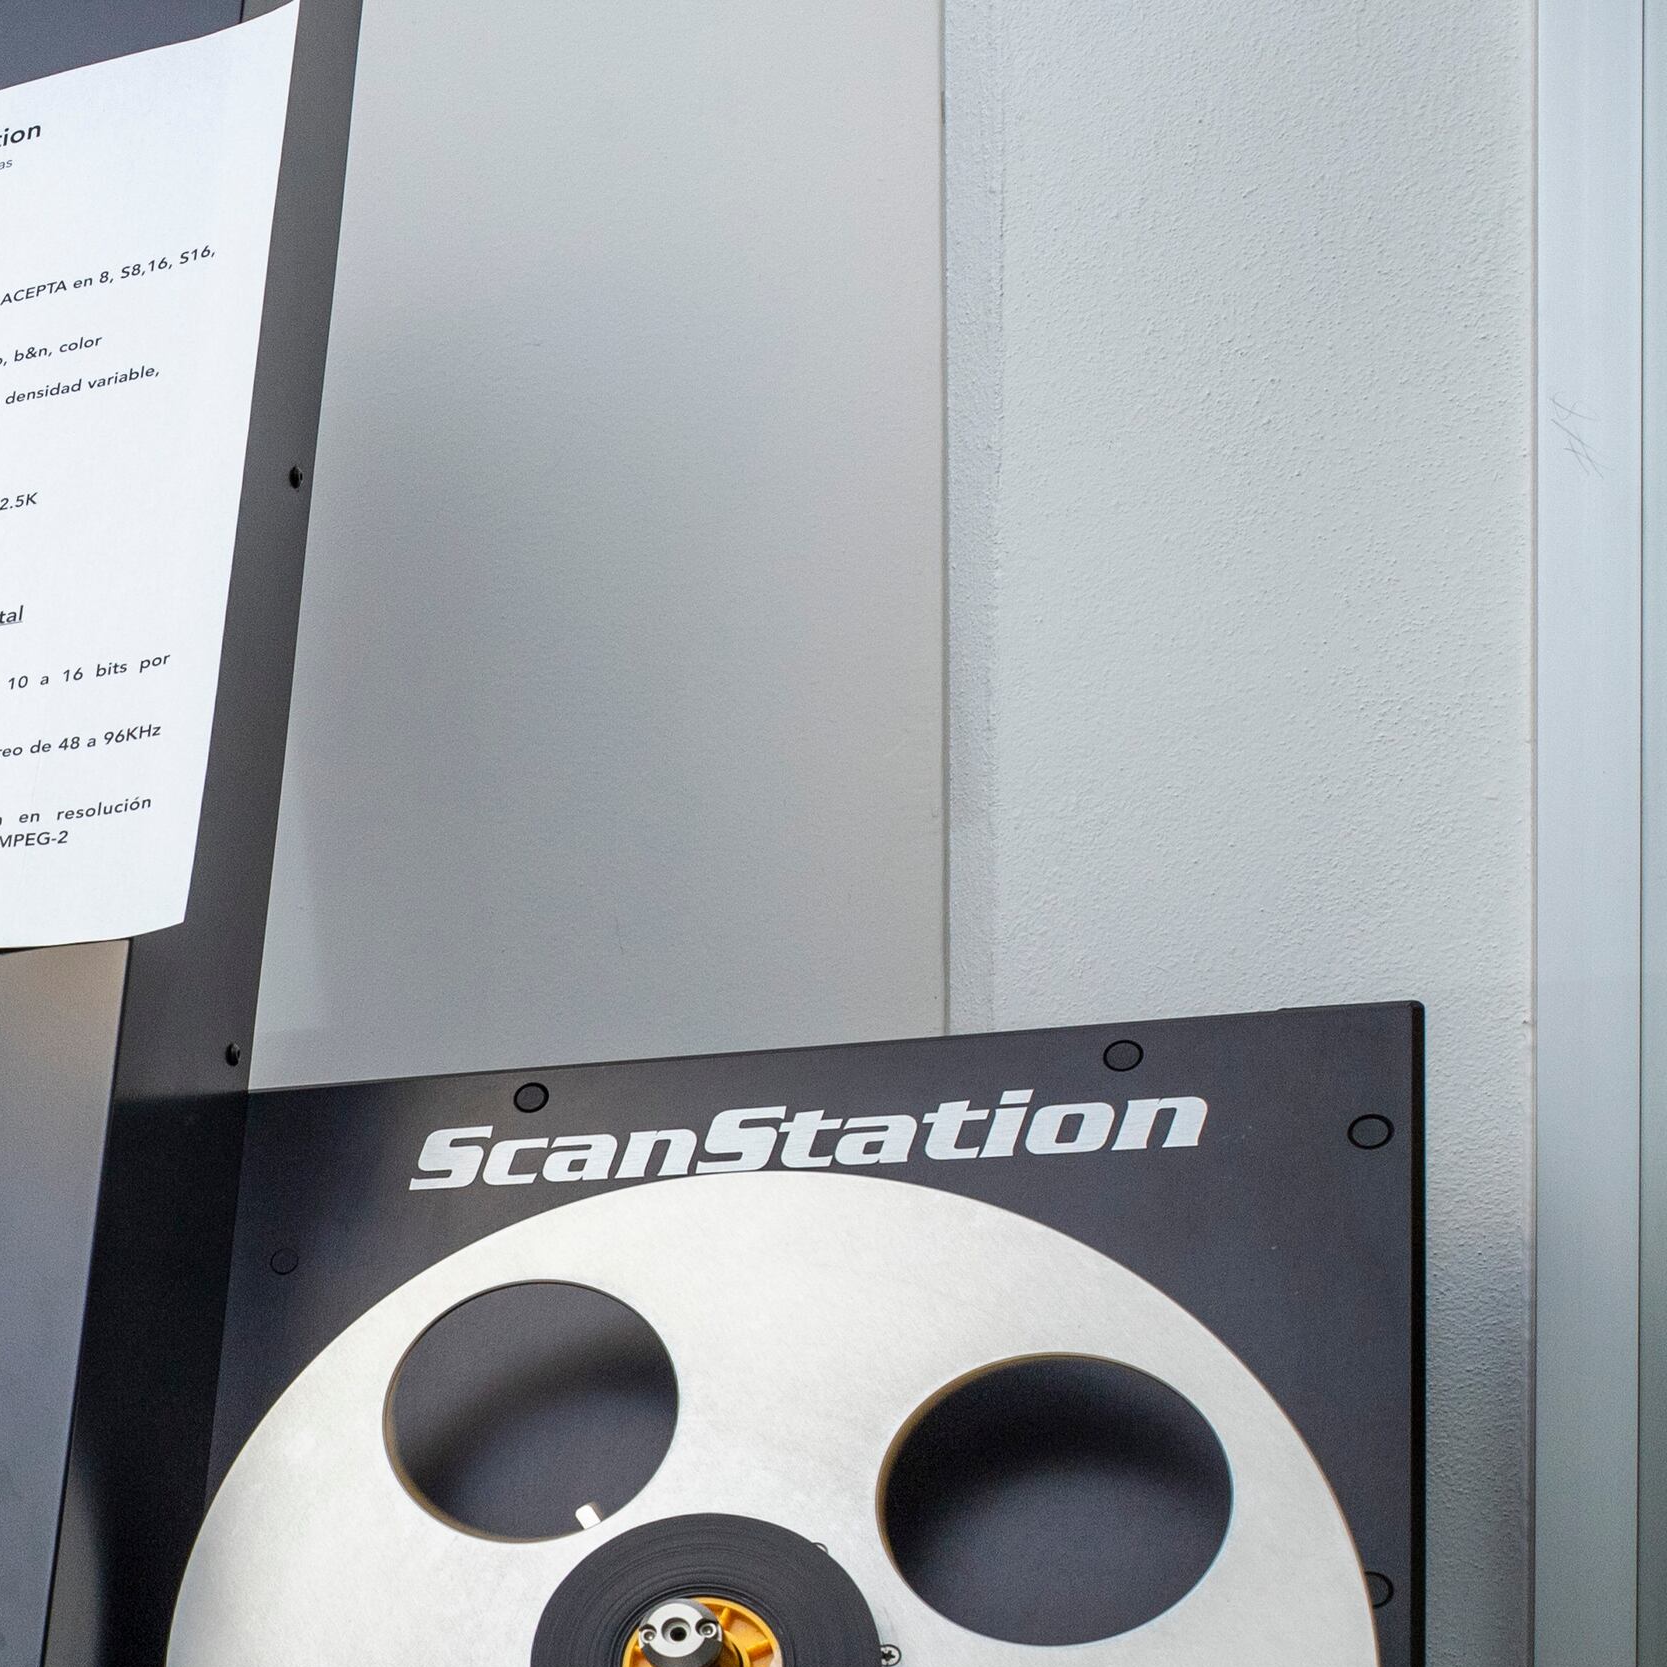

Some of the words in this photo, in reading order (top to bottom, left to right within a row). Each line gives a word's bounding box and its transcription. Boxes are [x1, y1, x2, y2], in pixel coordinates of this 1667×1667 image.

[0, 280, 67, 305] ACEPTA
[73, 278, 92, 288] en
[99, 271, 113, 283] 8,
[121, 257, 172, 279] S8,16,
[180, 245, 215, 264] S16,
[14, 347, 52, 362] b&n,
[59, 337, 102, 352] color
[6, 378, 82, 404] densidad
[88, 365, 159, 389] variable,
[0, 492, 38, 511] 2.5K
[8, 675, 28, 690] 10
[63, 667, 83, 682] 16
[96, 662, 127, 677] bits
[139, 655, 170, 673] por
[30, 740, 51, 753] de
[58, 736, 80, 750] 48
[104, 724, 161, 745] 96KHz
[19, 813, 40, 823] en
[57, 797, 151, 820] resolución
[409, 1089, 1208, 1190] ScanStation
